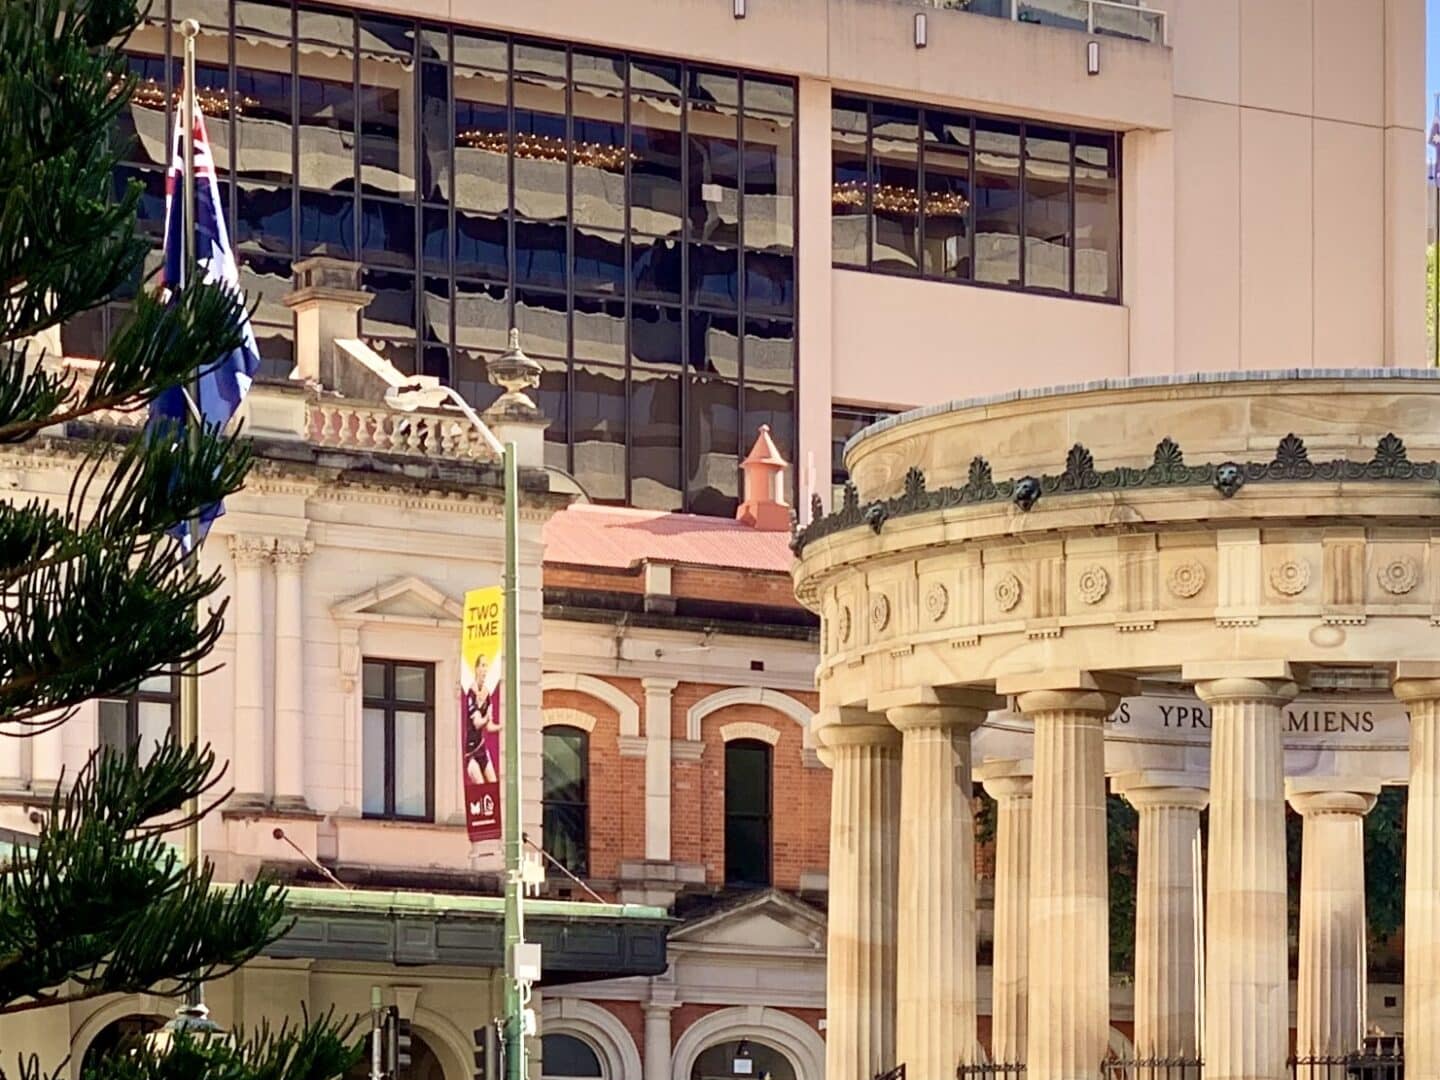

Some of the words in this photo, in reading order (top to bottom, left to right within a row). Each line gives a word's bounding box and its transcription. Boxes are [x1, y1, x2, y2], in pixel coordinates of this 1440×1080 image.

[469, 602, 498, 621] TWO
[467, 620, 498, 640] TIME
[1159, 704, 1212, 728] YPR
[1282, 711, 1374, 732] MIENS
